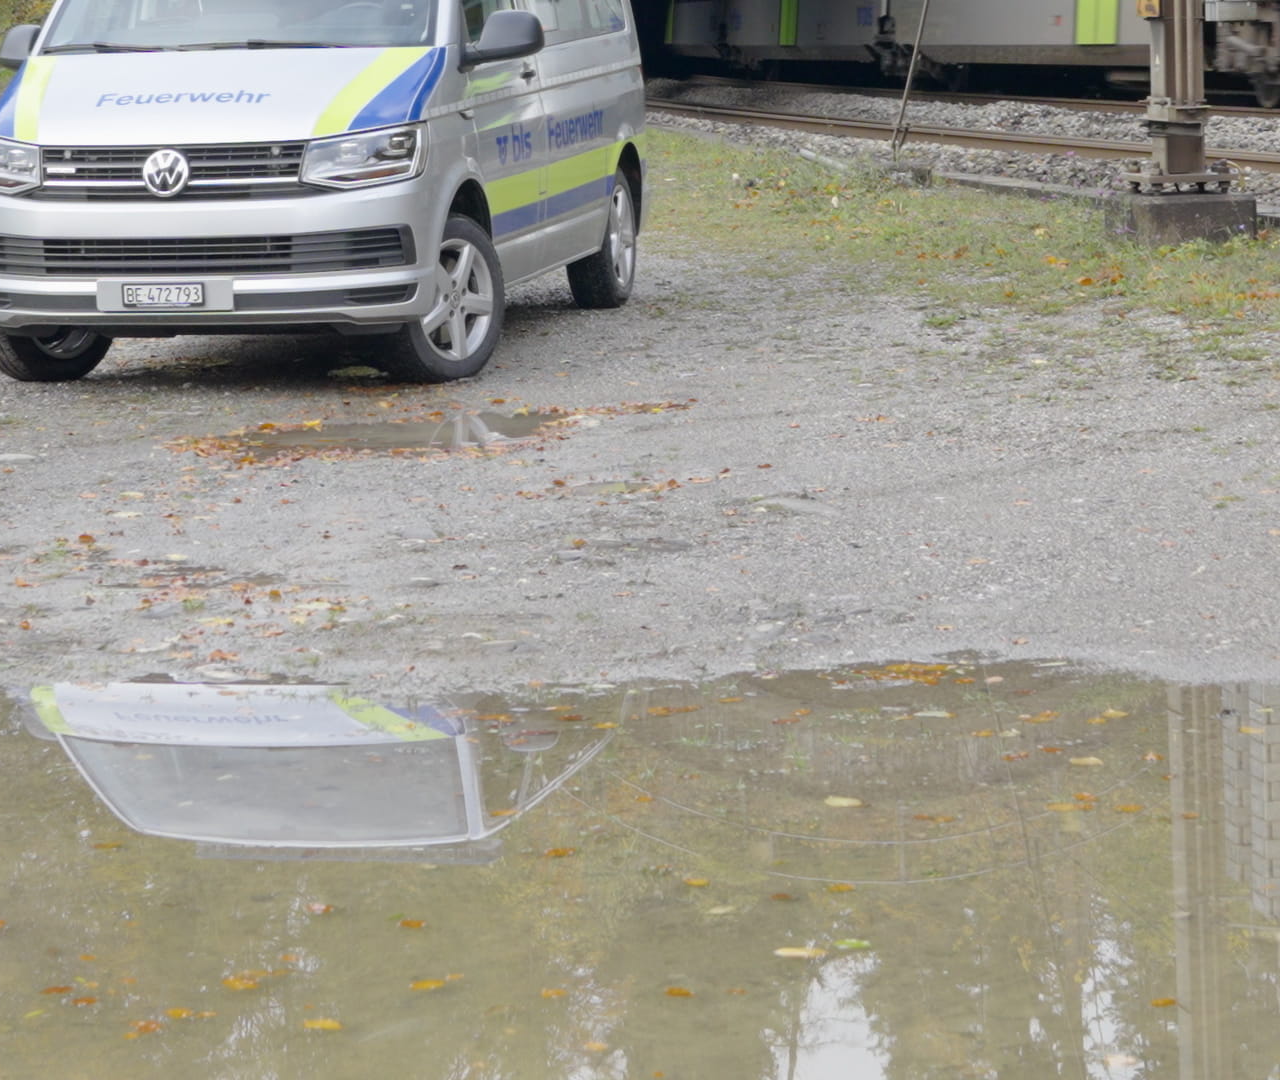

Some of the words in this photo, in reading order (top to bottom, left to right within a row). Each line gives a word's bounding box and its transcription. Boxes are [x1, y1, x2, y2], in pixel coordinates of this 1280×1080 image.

[95, 89, 271, 108] Feuerwehr
[511, 122, 532, 163] bls
[546, 108, 604, 152] Feuerwehr
